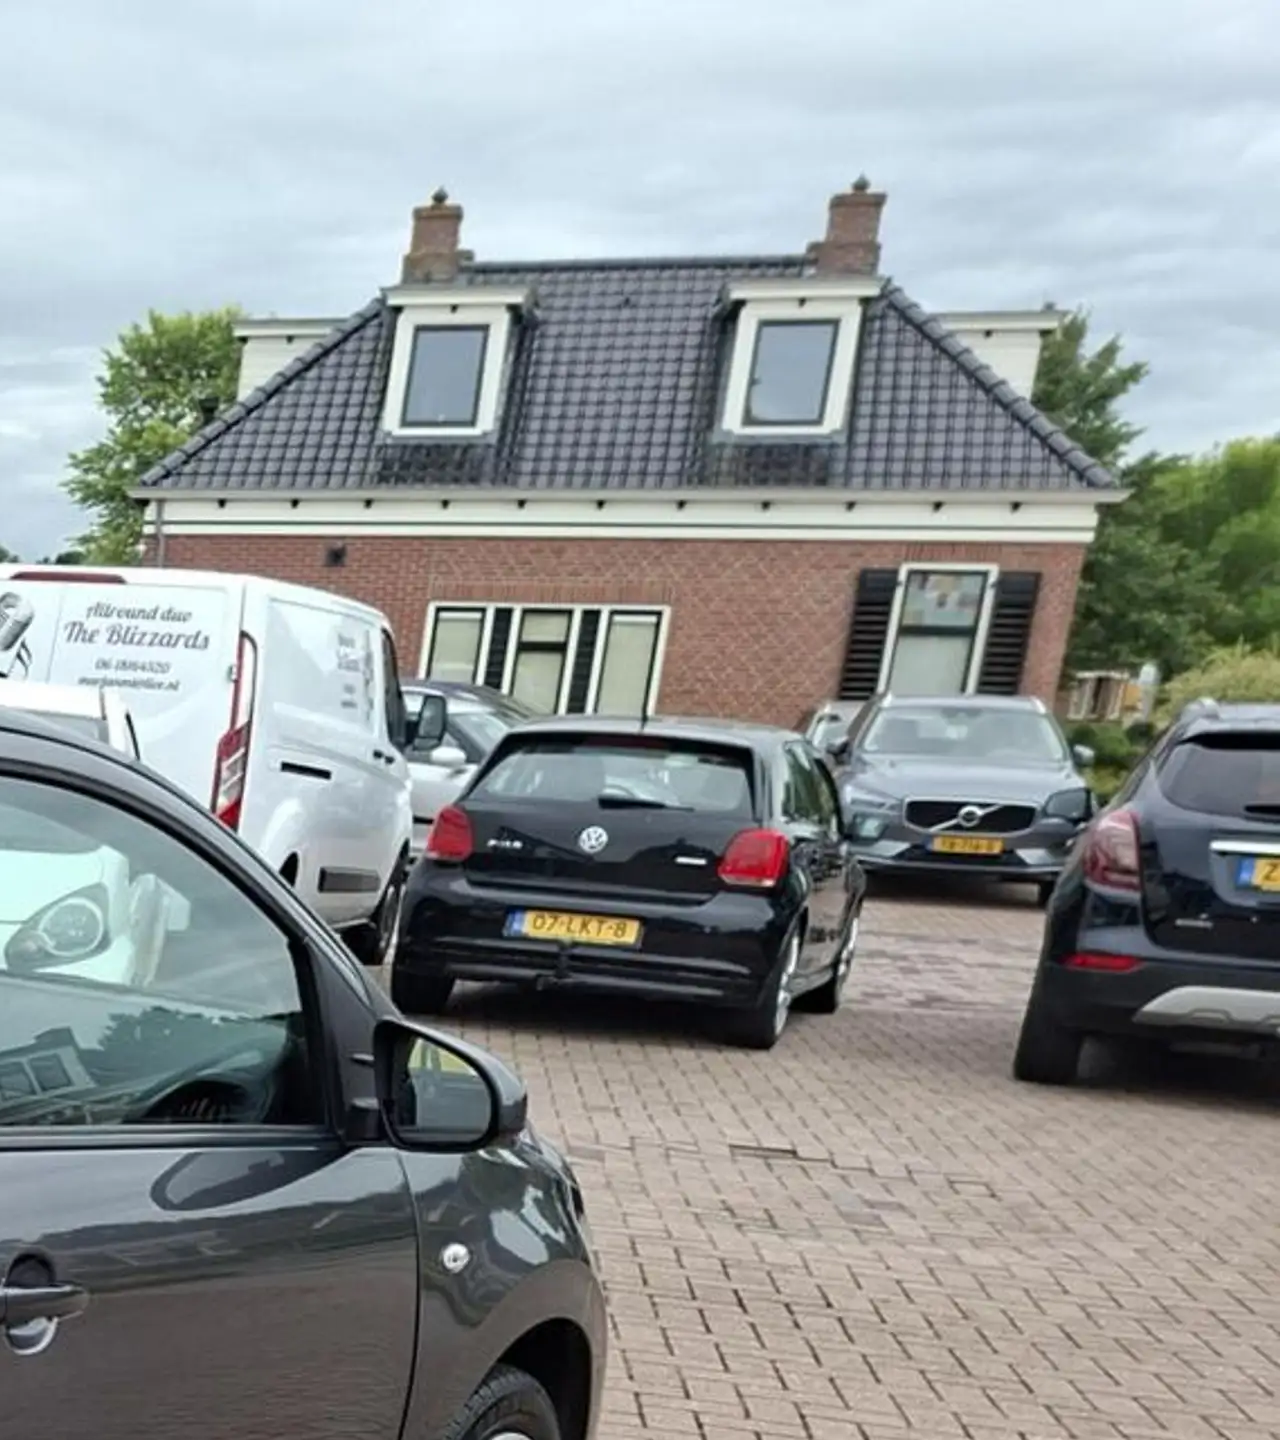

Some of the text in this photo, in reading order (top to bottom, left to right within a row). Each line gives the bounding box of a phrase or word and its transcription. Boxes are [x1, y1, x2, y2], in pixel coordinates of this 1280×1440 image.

[86, 602, 158, 621] Allround
[64, 620, 210, 650] The Blizzards
[532, 914, 628, 939] 07-LKT-8
